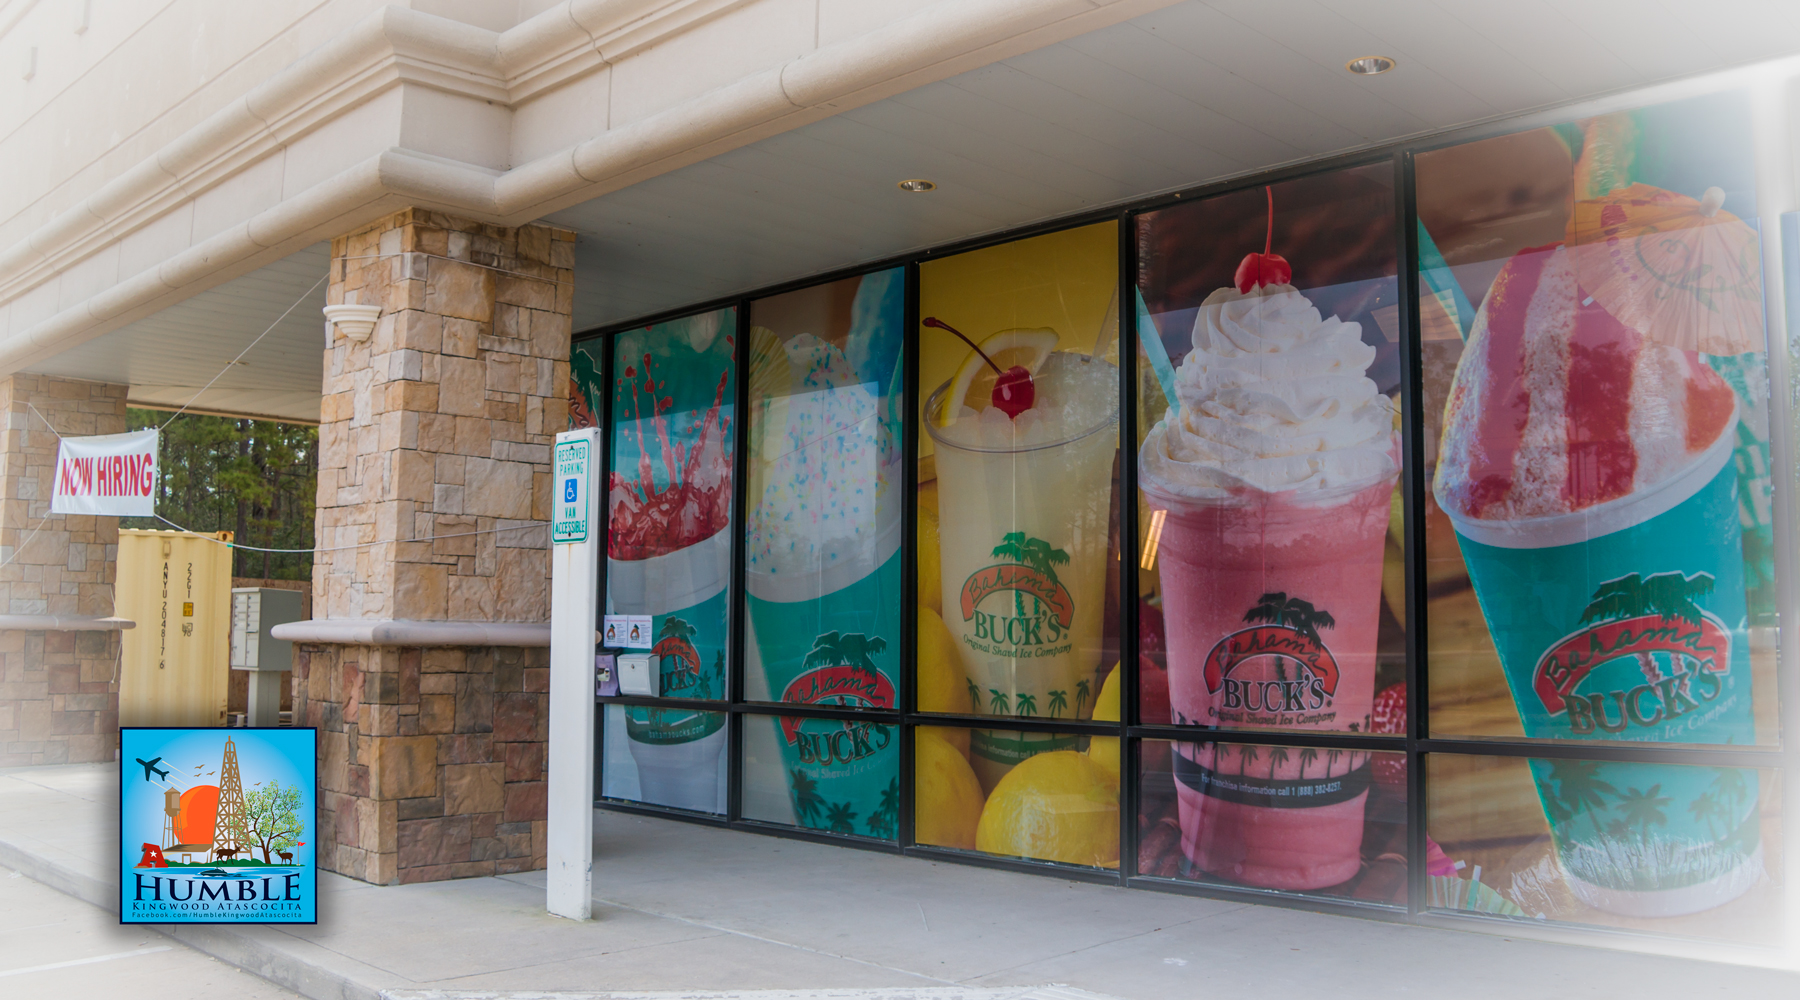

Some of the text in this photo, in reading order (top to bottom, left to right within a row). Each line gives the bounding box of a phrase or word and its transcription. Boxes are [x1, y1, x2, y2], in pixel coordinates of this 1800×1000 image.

[558, 447, 585, 462] RESERVED
[560, 462, 583, 476] PARKING
[59, 452, 153, 497] NOW HIRING
[555, 520, 585, 534] ACCESSIBLE
[565, 506, 576, 519] VAN
[968, 567, 1065, 611] Bahama
[963, 633, 991, 653] Original
[1019, 648, 1032, 659] Ice
[1034, 642, 1073, 659] Company
[973, 609, 1062, 646] BUCK'S
[1215, 633, 1328, 677] Bahama
[1545, 625, 1718, 693] Bahama
[660, 664, 697, 693] UCK'S
[1222, 674, 1325, 712] BUCK'S
[1559, 658, 1722, 735] BUCK'S
[1208, 706, 1244, 723] Original
[1279, 712, 1294, 725] Ice
[1296, 710, 1337, 726] Company
[1664, 724, 1683, 739] Ice
[1687, 694, 1737, 731] Company
[793, 722, 891, 766] BUCK'S
[1201, 773, 1210, 783] For
[1211, 776, 1238, 790] franchise
[1238, 782, 1277, 796] information
[1277, 786, 1290, 796] call
